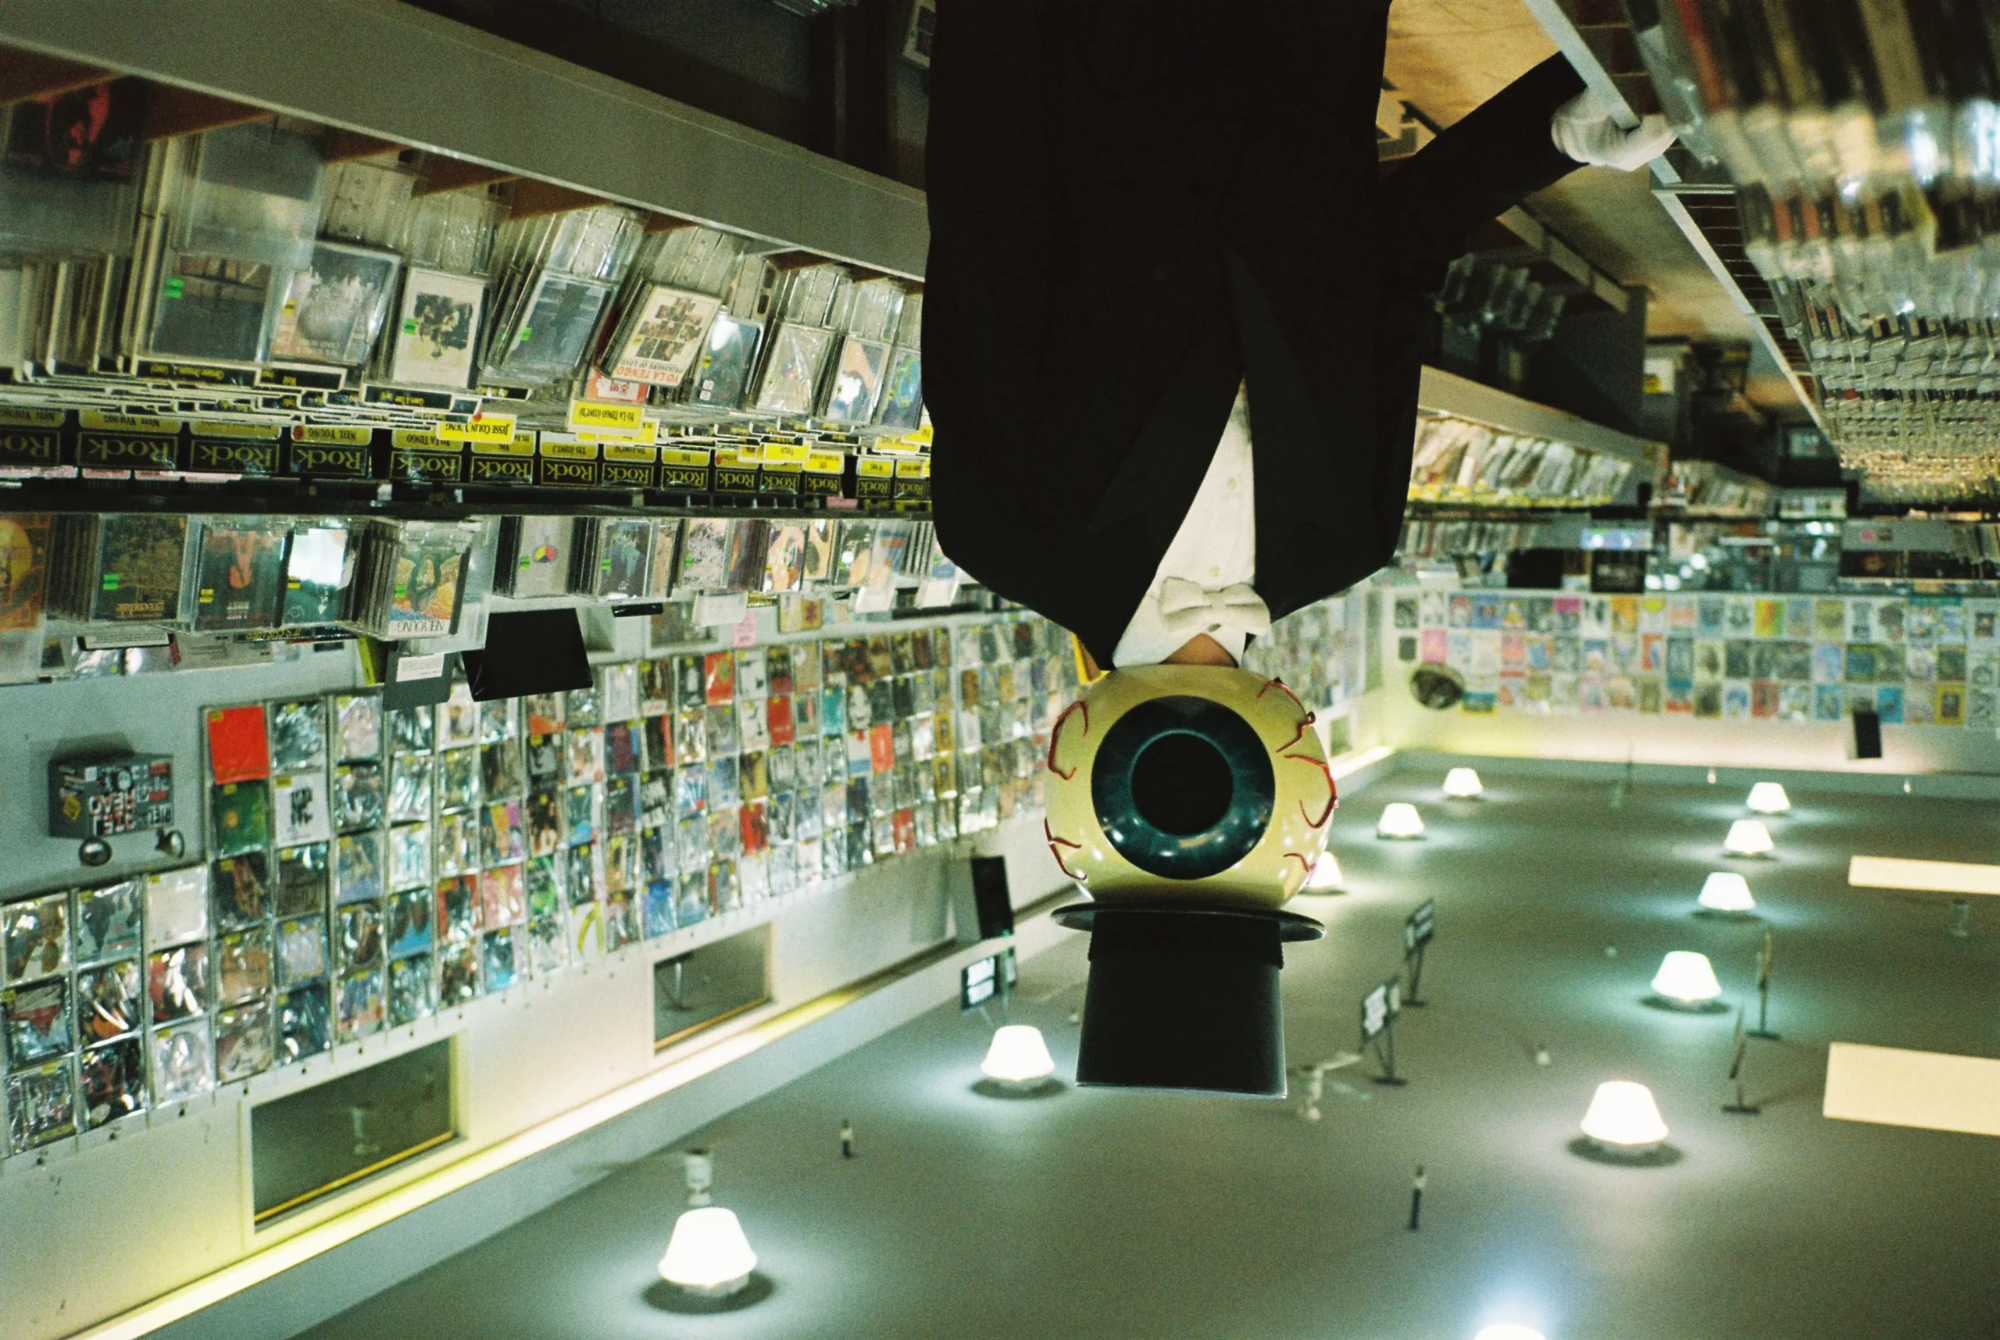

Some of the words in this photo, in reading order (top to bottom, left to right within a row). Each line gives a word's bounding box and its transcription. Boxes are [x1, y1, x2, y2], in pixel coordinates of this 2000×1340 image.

[616, 366, 650, 380] TENGO
[653, 370, 666, 381] LA
[666, 372, 678, 384] YO
[308, 428, 336, 440] YOUNG
[340, 430, 356, 440] NEIL
[446, 422, 468, 434] YOUNG
[471, 424, 490, 435] COLIN
[492, 424, 510, 436] JESSE
[0, 434, 50, 458] Ro
[88, 438, 168, 463] Rock
[200, 444, 272, 467] Rock
[296, 448, 362, 470] Rock
[398, 456, 456, 476] Rock
[477, 460, 528, 478] Rock
[546, 462, 592, 480] Rock
[607, 467, 649, 484] Rock
[666, 470, 704, 487] Rock
[719, 472, 755, 489] Rock
[764, 476, 796, 491] Rock
[808, 477, 838, 492] Rock
[860, 481, 888, 494] Rock
